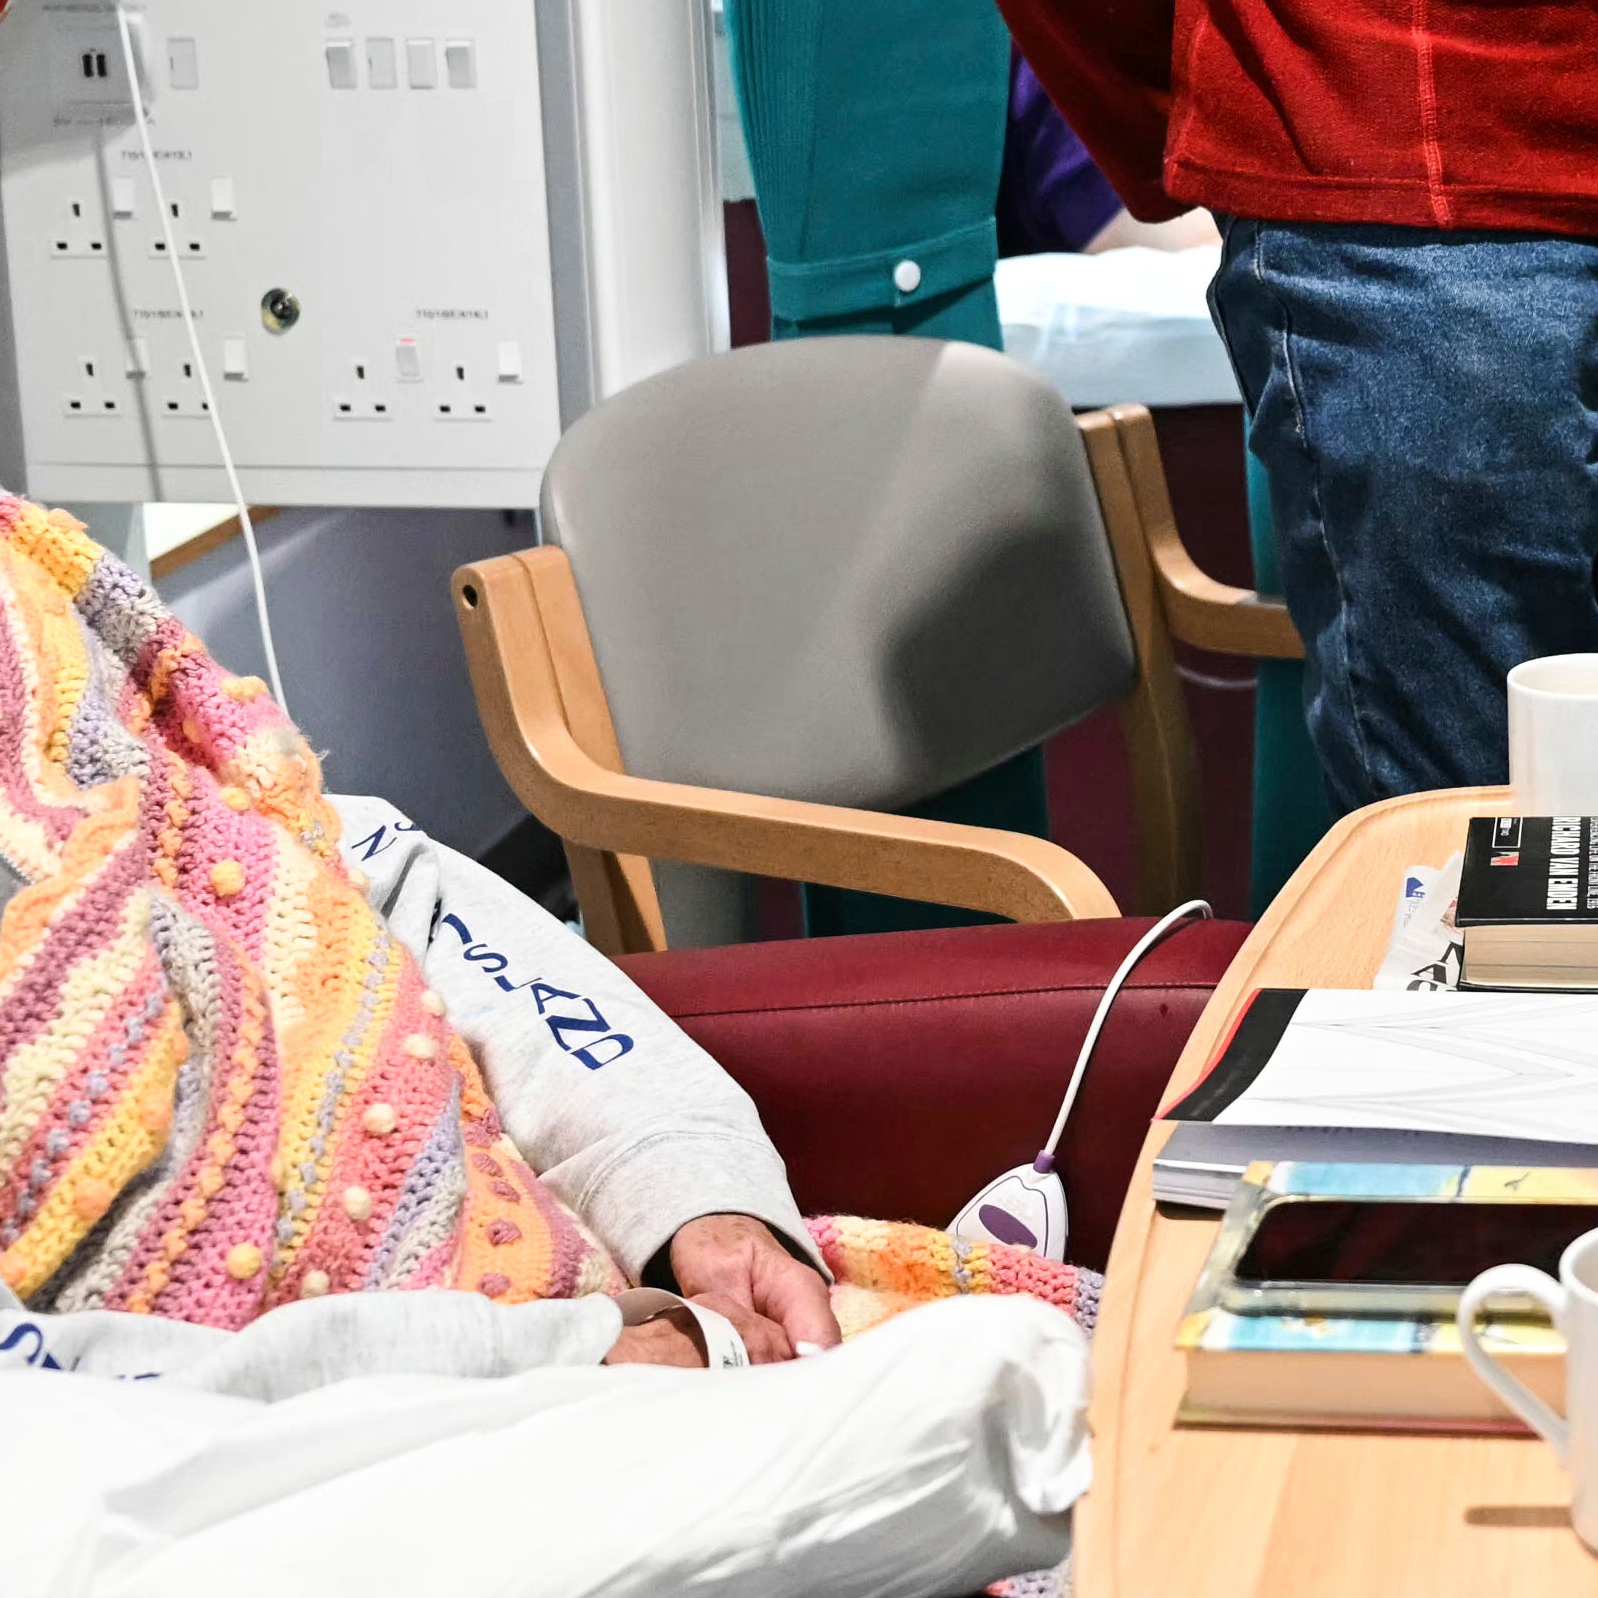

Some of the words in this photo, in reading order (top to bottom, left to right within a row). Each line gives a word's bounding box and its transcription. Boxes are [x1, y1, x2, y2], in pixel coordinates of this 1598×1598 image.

[1551, 817, 1581, 855] RICHARD
[1549, 857, 1580, 876] VAN
[1546, 878, 1578, 910] EMDEN
[442, 913, 634, 1070] ISLAND
